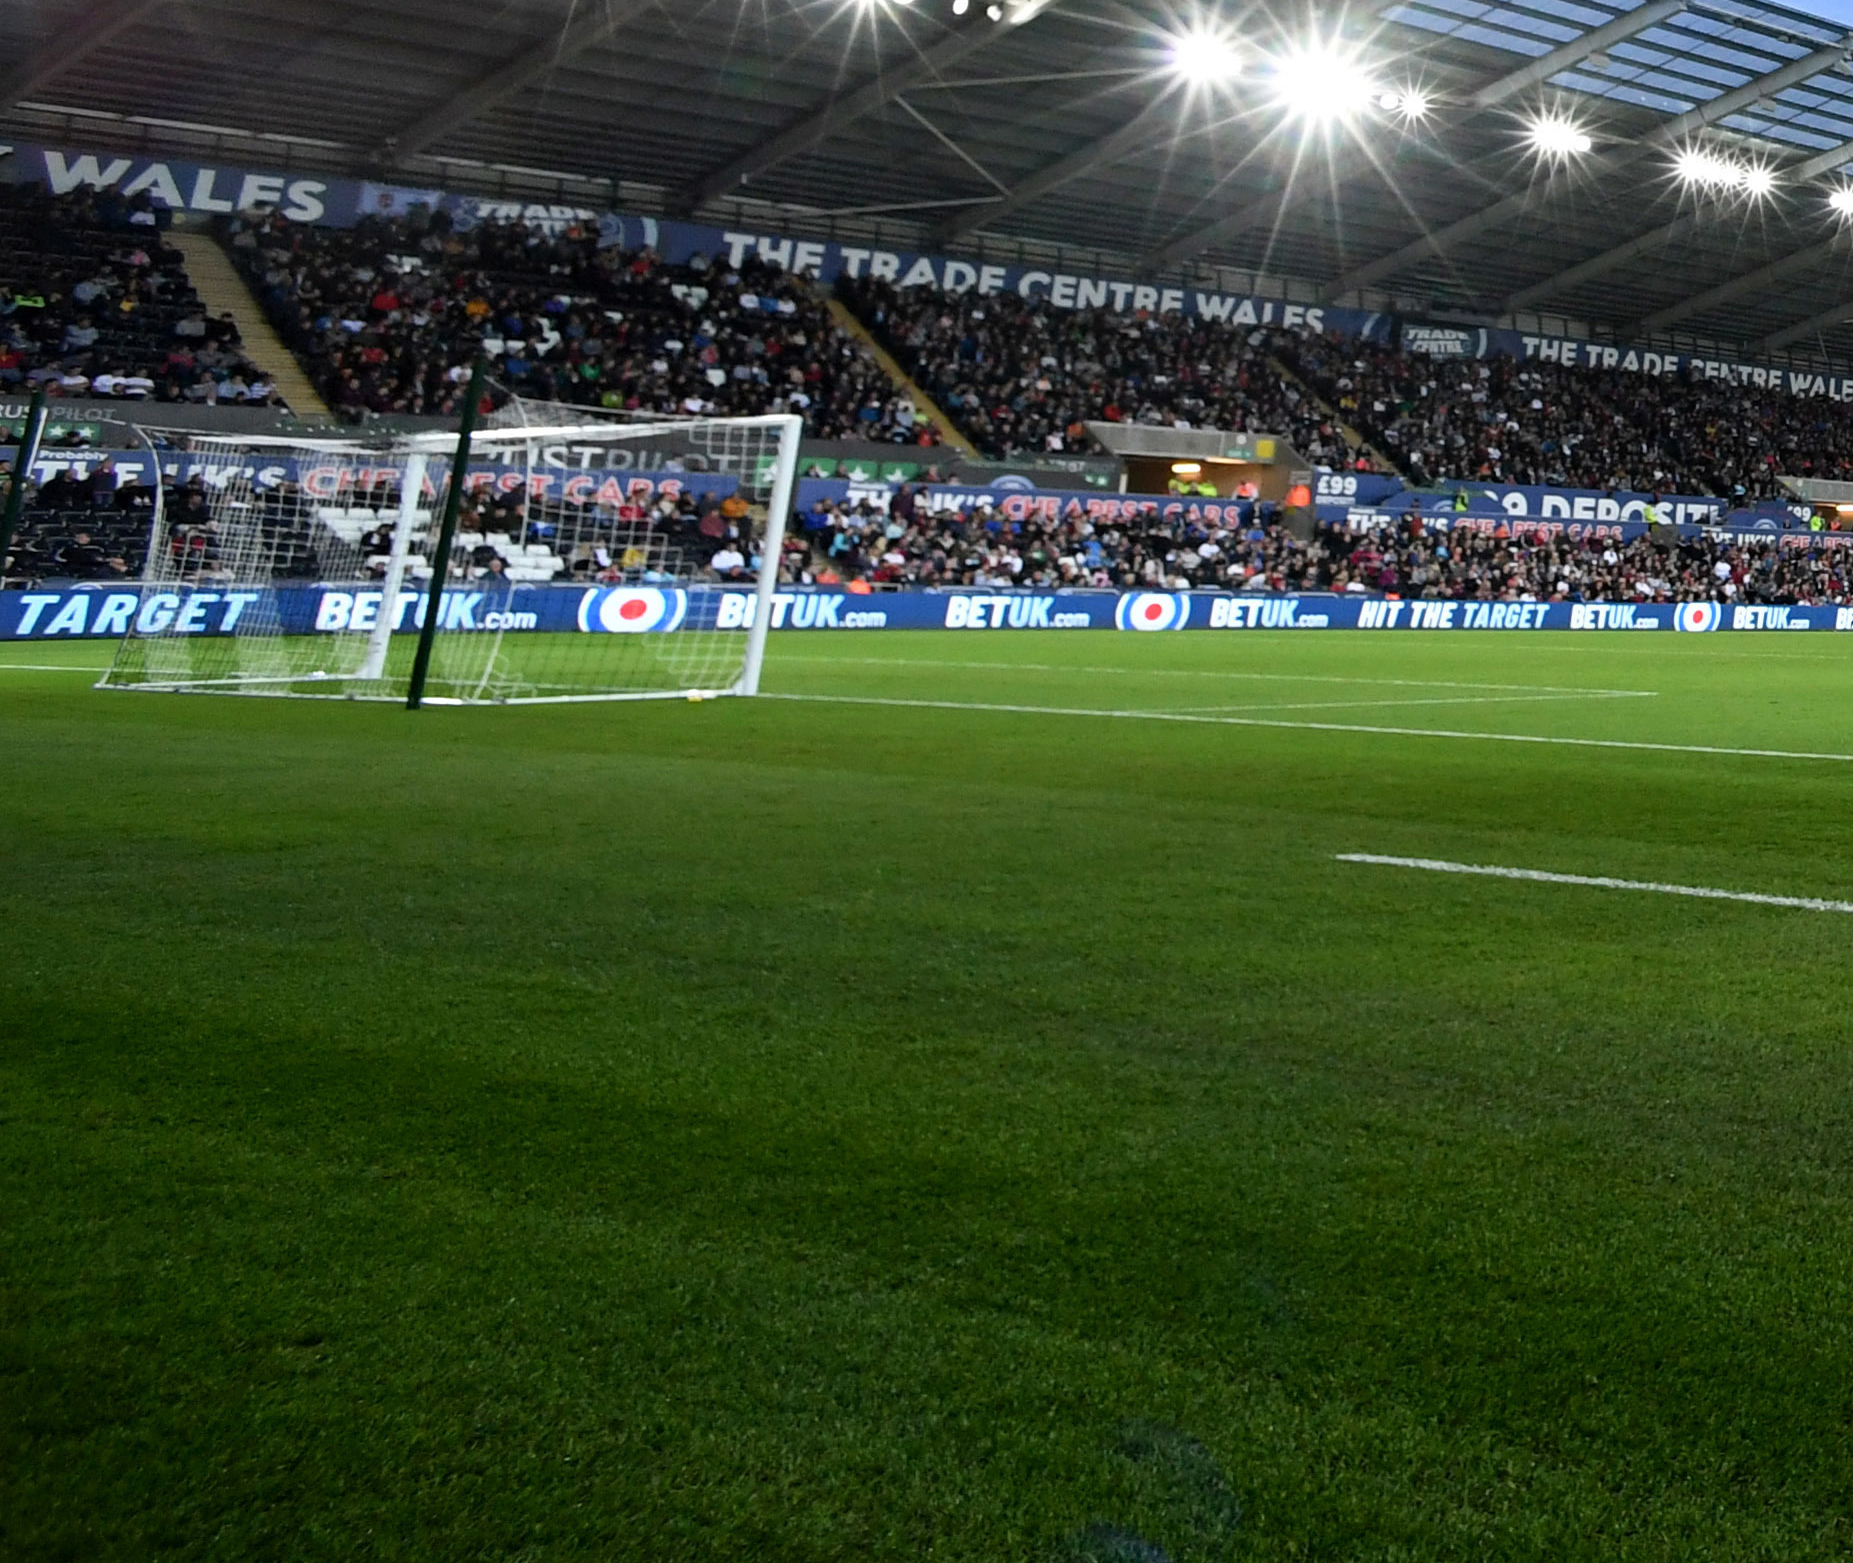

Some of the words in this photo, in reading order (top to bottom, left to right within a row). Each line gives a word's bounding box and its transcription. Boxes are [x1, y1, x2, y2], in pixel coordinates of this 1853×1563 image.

[44, 150, 327, 222] WALES
[723, 232, 826, 279] THE
[840, 247, 1007, 295] TRADE
[1018, 271, 1184, 314] CENTRE
[1195, 292, 1326, 334] WALES
[1521, 337, 1578, 367] THE
[1585, 345, 1679, 377] TRADE
[1317, 475, 1358, 496] £99
[15, 593, 259, 635] TARGET
[314, 591, 538, 631] BETUK.com
[716, 592, 888, 629] BTUK.com
[944, 594, 1090, 628] BETUK.com
[1210, 598, 1329, 628] BETUK.com
[1357, 600, 1404, 629] HIT
[1410, 600, 1454, 629] THE
[1463, 602, 1550, 629] TARGET
[1570, 603, 1659, 629] BETUK.com
[1733, 606, 1810, 630] BETUK.com
